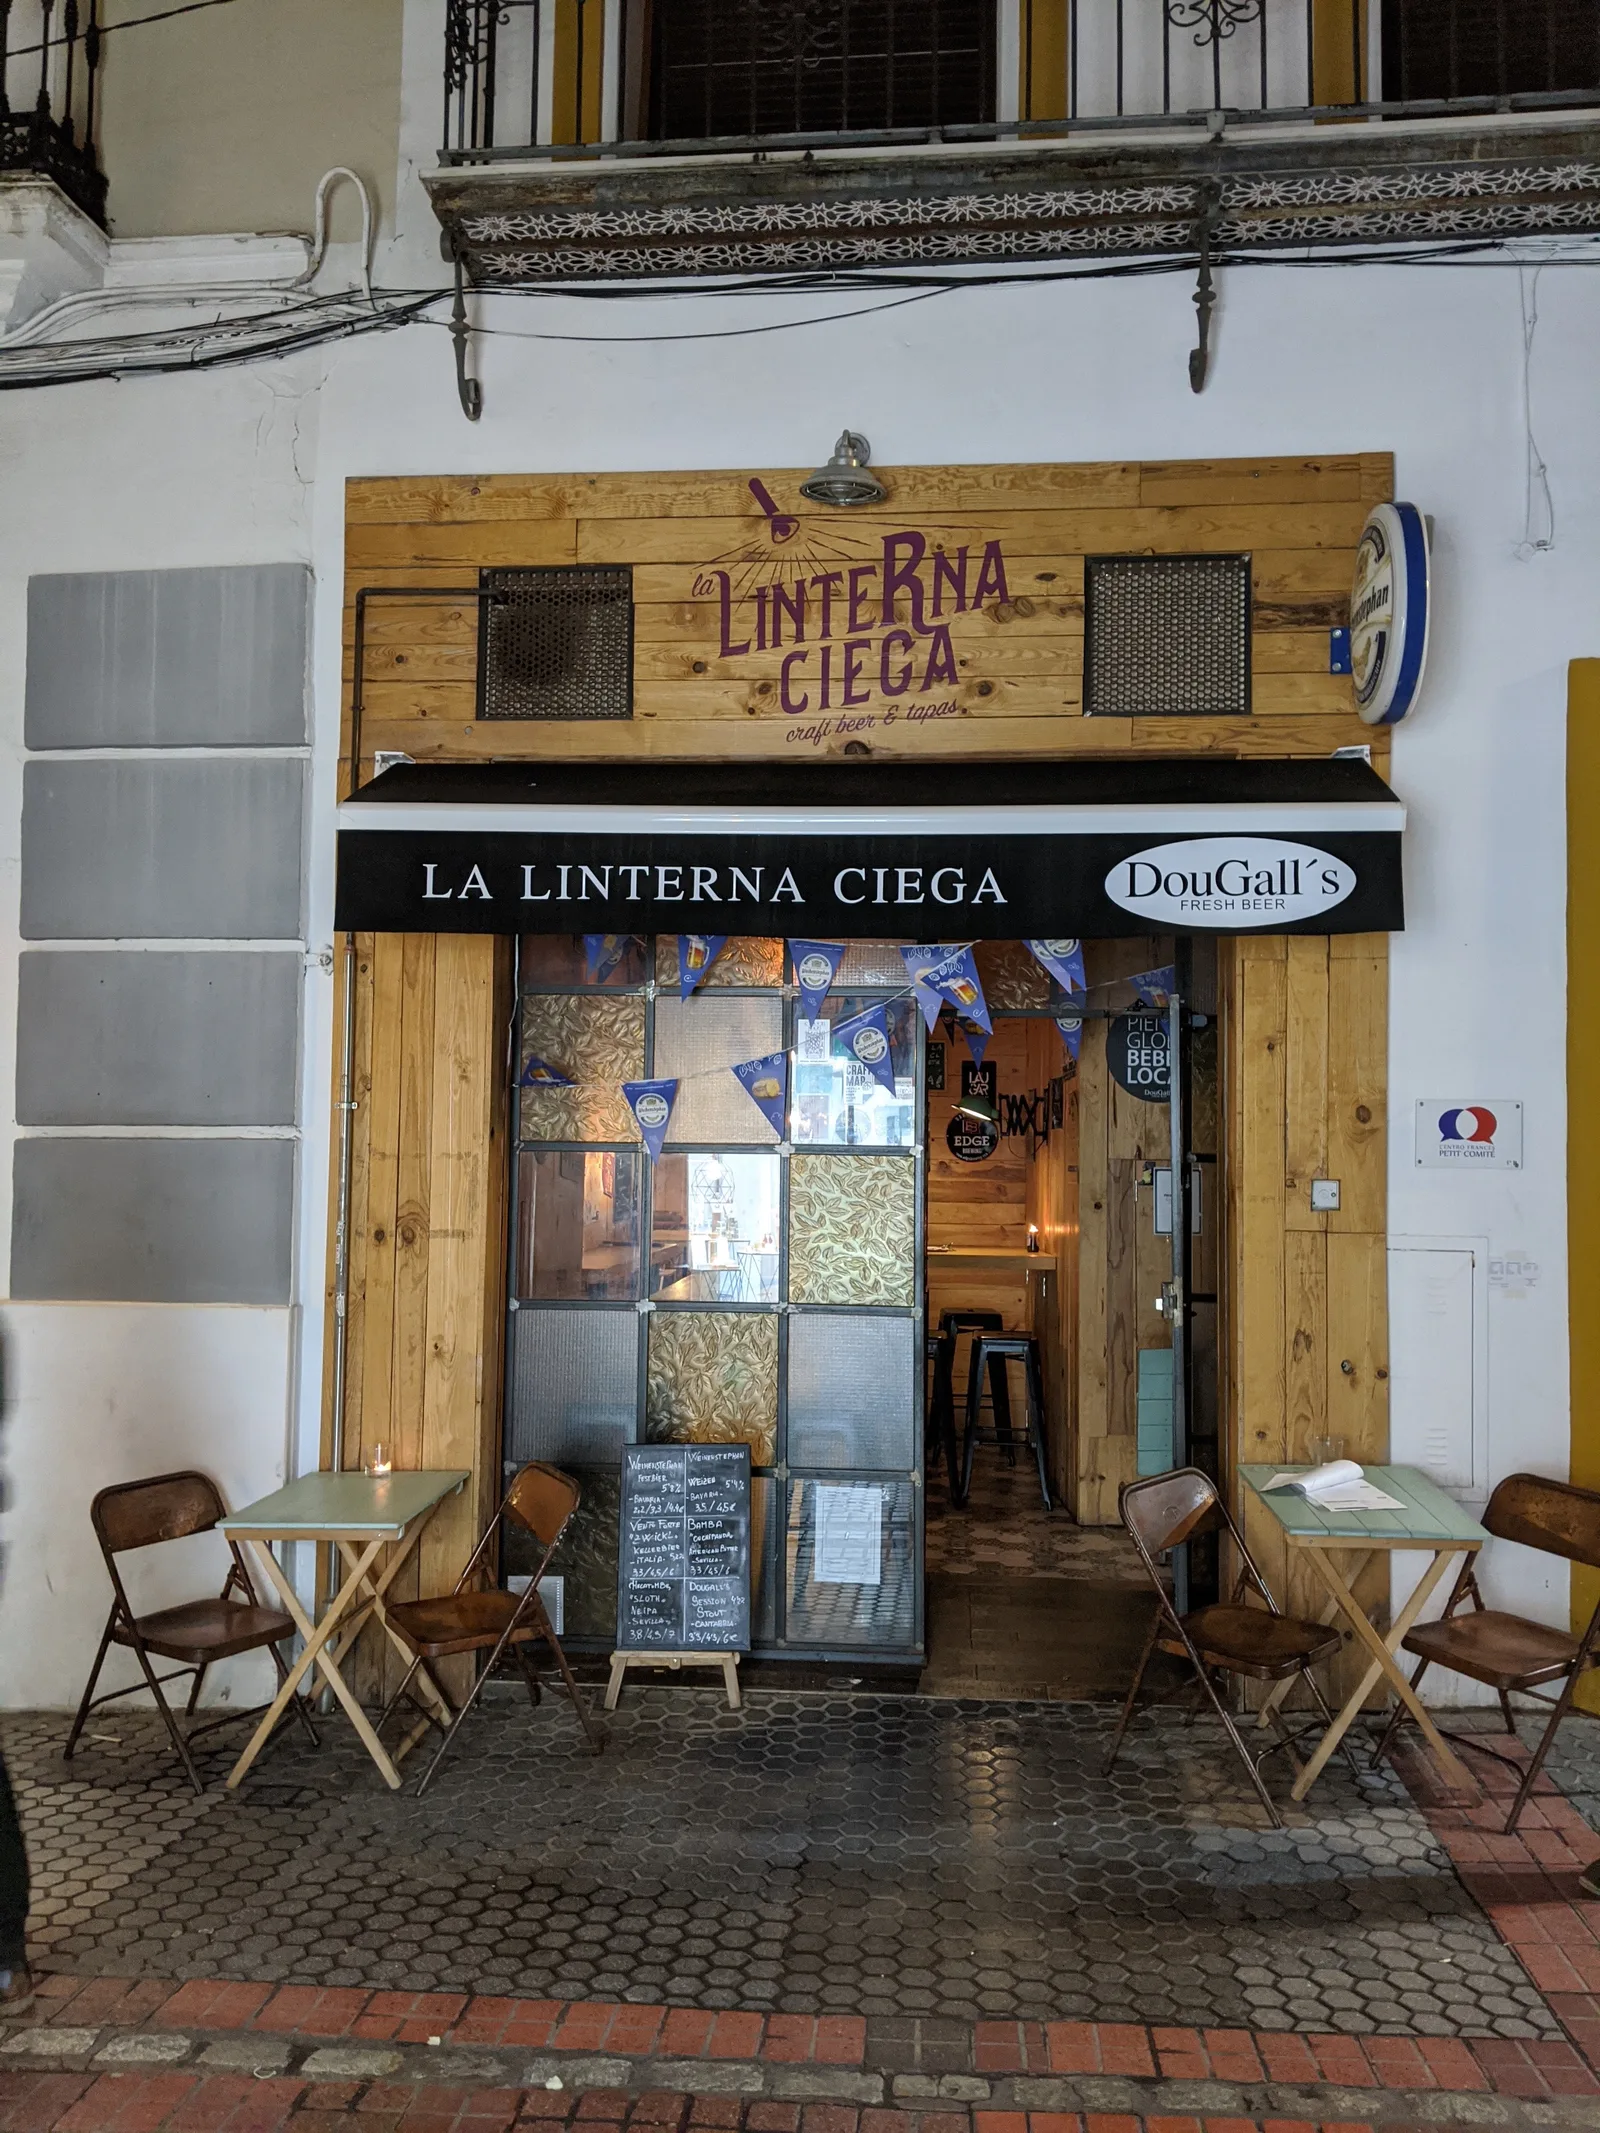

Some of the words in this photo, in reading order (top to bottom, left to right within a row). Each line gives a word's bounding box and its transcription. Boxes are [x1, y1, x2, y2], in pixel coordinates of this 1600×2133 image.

[692, 572, 715, 597] la
[710, 531, 1011, 658] LINTERNA
[780, 623, 960, 714] CIEGA
[786, 718, 831, 746] craft
[835, 713, 876, 735] beer
[884, 704, 898, 724] &
[907, 698, 959, 727] tapas
[422, 864, 493, 899] LA
[520, 865, 806, 902] LINTERNA
[833, 867, 1008, 903] CIEGA
[1180, 899, 1235, 911] FRESH
[1242, 898, 1286, 910] BEER
[1127, 1032, 1171, 1049] GLO
[846, 1076, 867, 1086] MAP
[1127, 1067, 1171, 1084] LOC
[954, 1136, 990, 1146] EDGE
[688, 1518, 723, 1530] BAMBA
[691, 1595, 727, 1607] SESSION
[697, 1606, 727, 1618] STOUT
